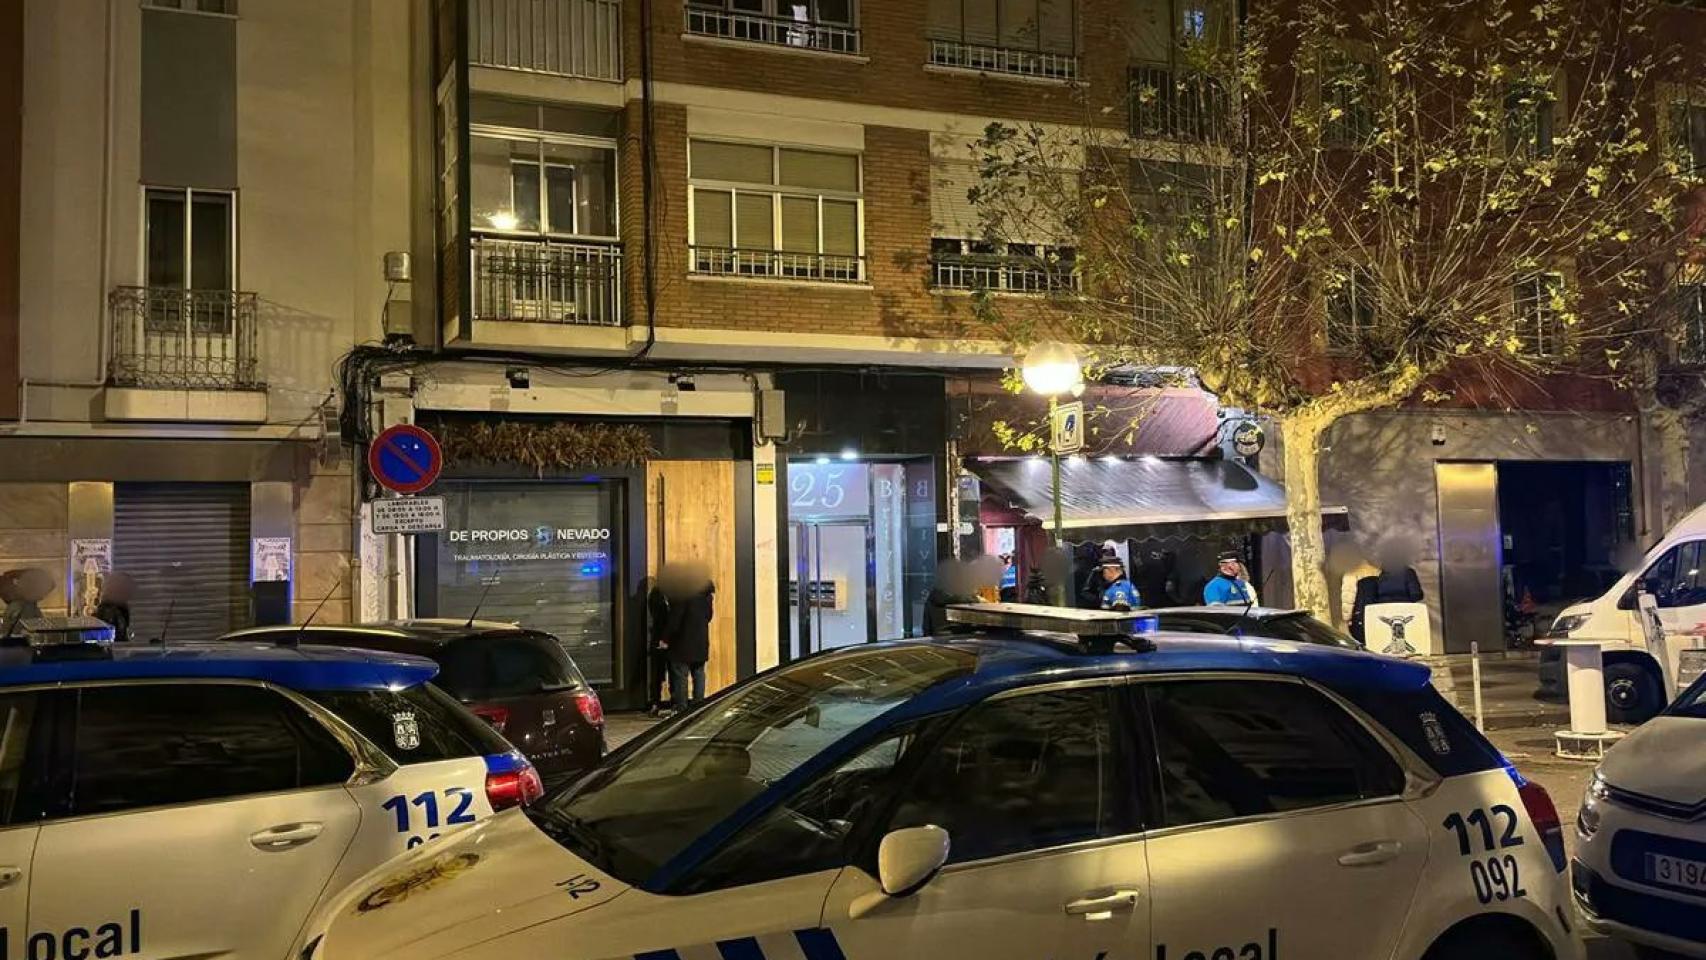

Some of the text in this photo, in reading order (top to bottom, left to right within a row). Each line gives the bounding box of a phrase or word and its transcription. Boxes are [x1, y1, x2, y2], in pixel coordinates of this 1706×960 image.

[791, 470, 845, 508] 25
[450, 528, 610, 542] DE PROPIOS NEVADO
[381, 787, 476, 833] 112
[1442, 804, 1524, 856] 112
[1470, 854, 1526, 904] 092
